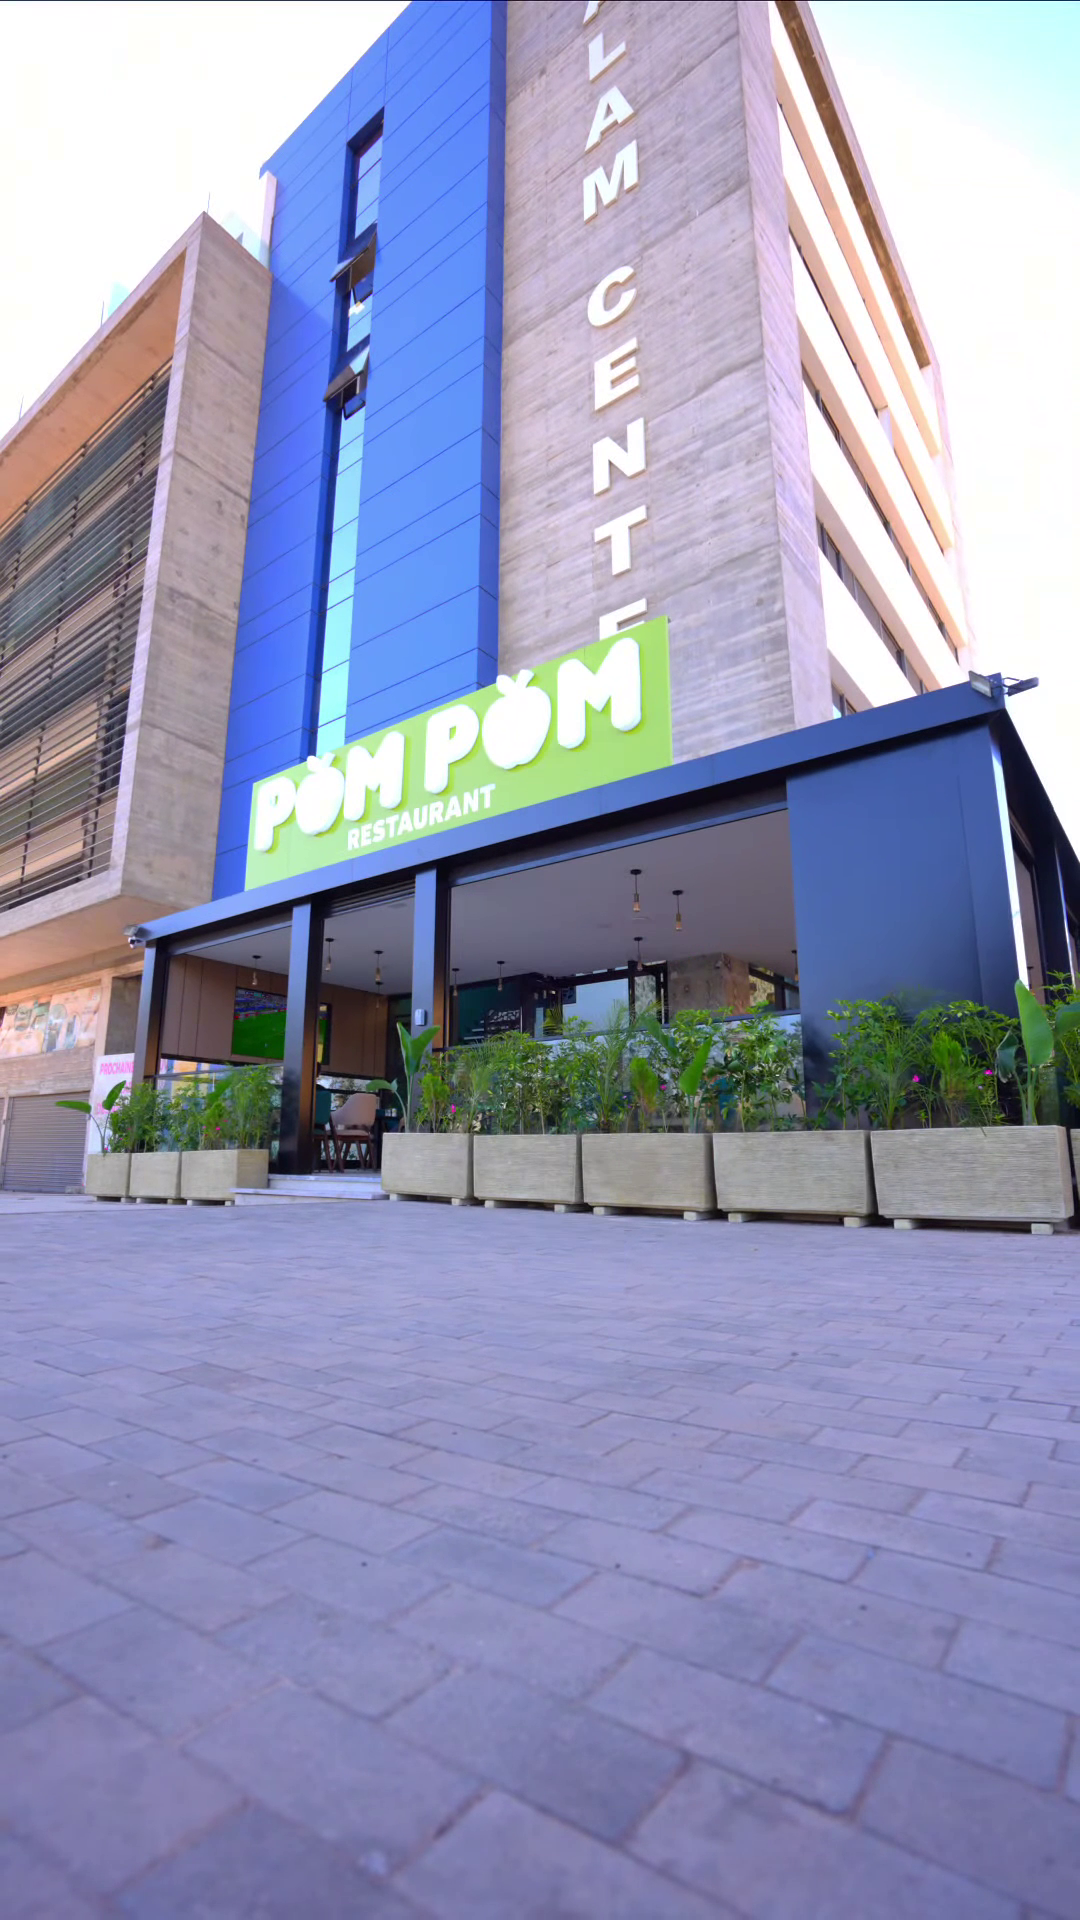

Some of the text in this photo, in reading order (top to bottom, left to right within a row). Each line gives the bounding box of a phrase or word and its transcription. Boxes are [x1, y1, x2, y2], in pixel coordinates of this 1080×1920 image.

[254, 638, 642, 852] POM POM
[347, 784, 496, 851] RESTAURANT
